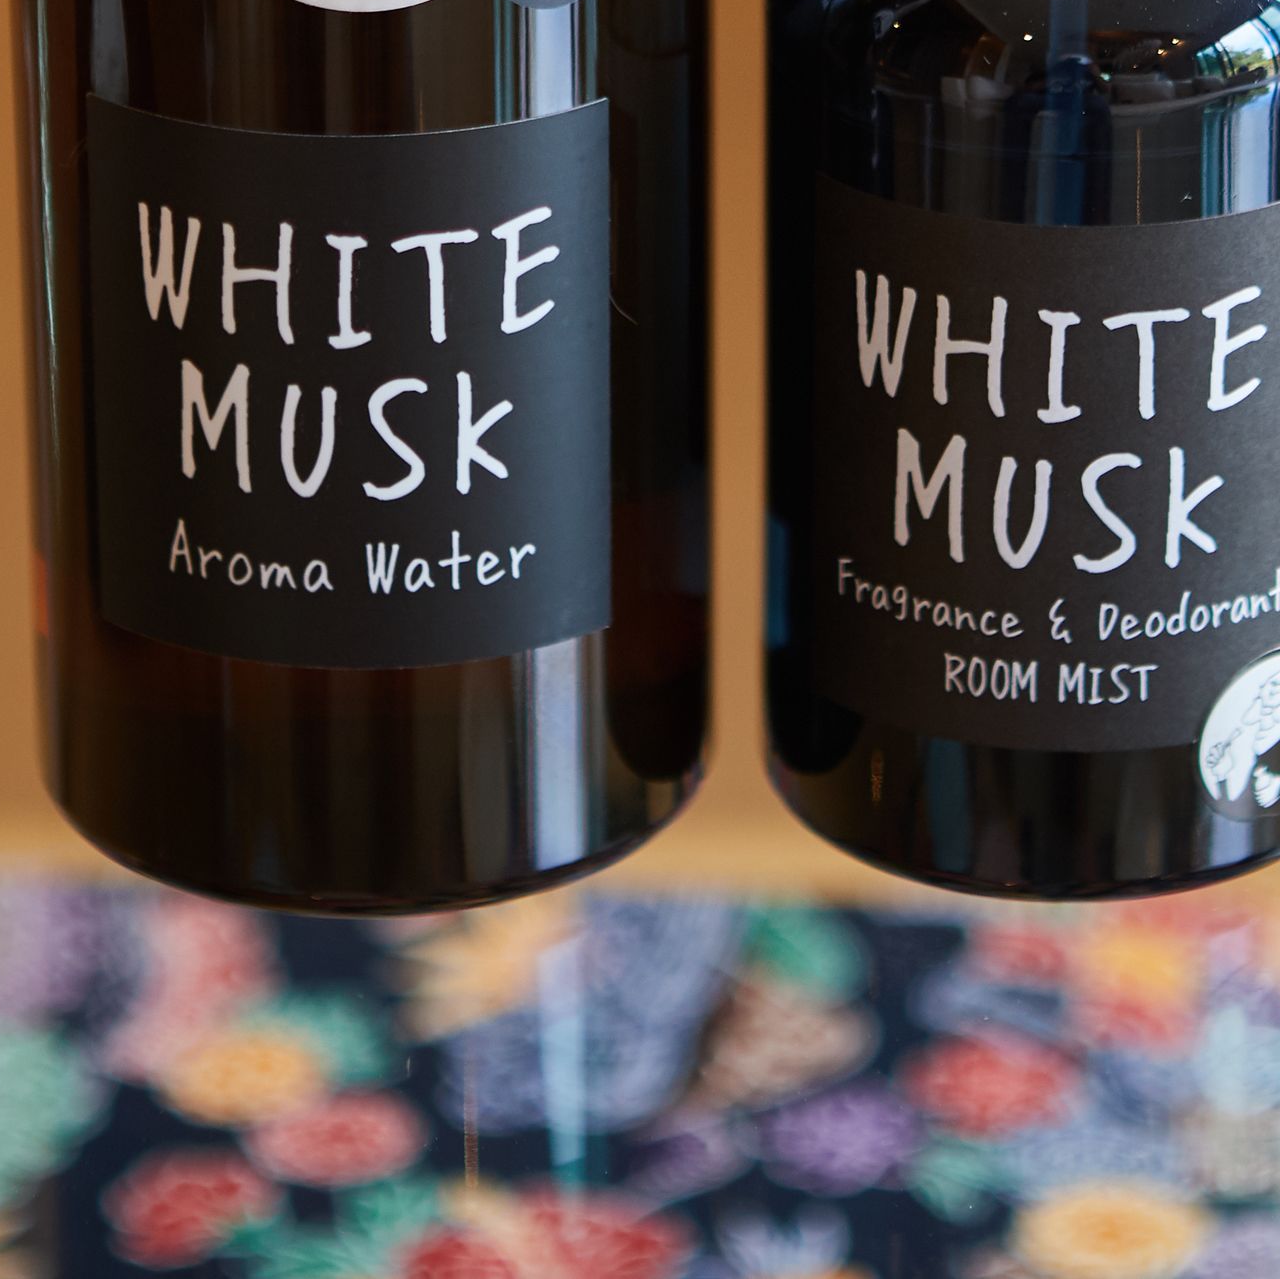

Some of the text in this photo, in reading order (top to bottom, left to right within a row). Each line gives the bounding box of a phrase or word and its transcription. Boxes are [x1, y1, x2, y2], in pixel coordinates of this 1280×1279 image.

[138, 202, 561, 350] WHITE
[856, 270, 1269, 424] WHITE
[169, 518, 537, 594] Aroma Water
[837, 557, 1024, 639] Fragrance
[1048, 598, 1073, 645] &
[943, 653, 1159, 705] ROOM MIST
